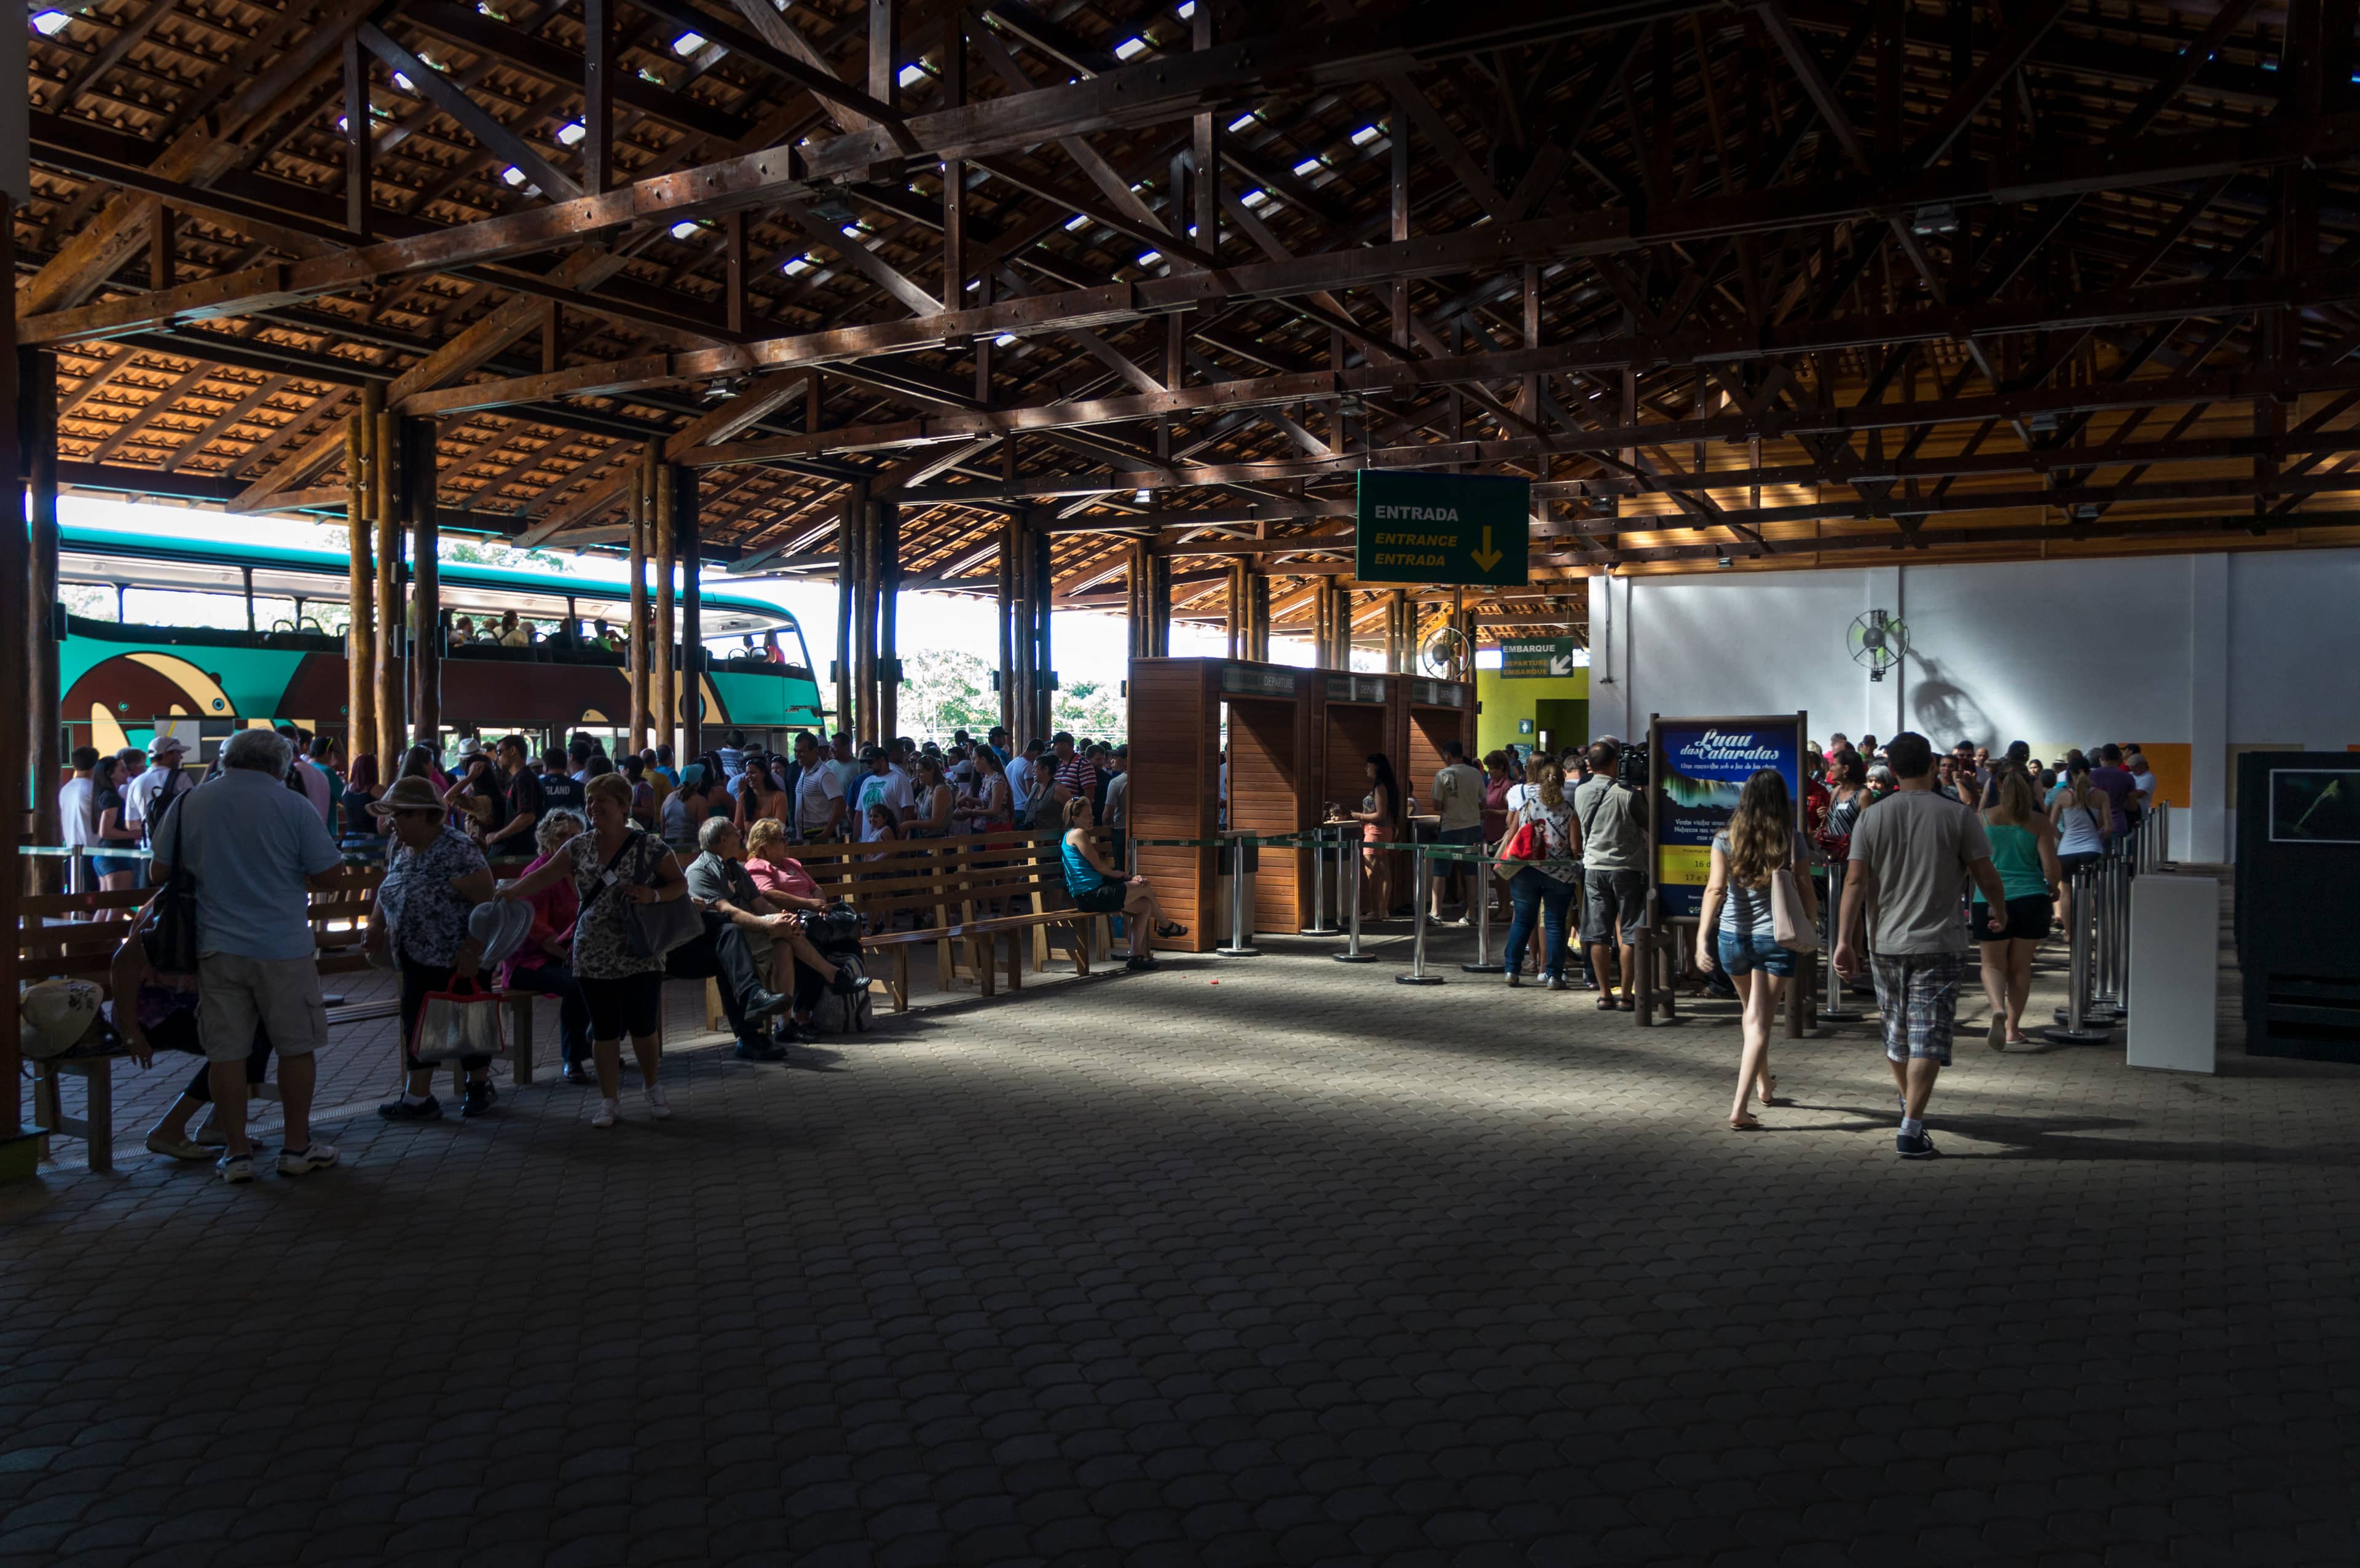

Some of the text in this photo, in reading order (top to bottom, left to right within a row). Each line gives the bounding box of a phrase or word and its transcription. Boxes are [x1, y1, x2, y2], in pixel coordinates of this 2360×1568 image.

[1375, 505, 1458, 522] ENTRADA
[1374, 533, 1457, 547] ENTRANCE
[1374, 553, 1446, 566] ENTRADA
[1502, 645, 1556, 653] EMBARQUE
[1264, 676, 1294, 689] DEPARTURE
[1694, 728, 1753, 751] Luau
[1680, 745, 1780, 760] das Cataratas
